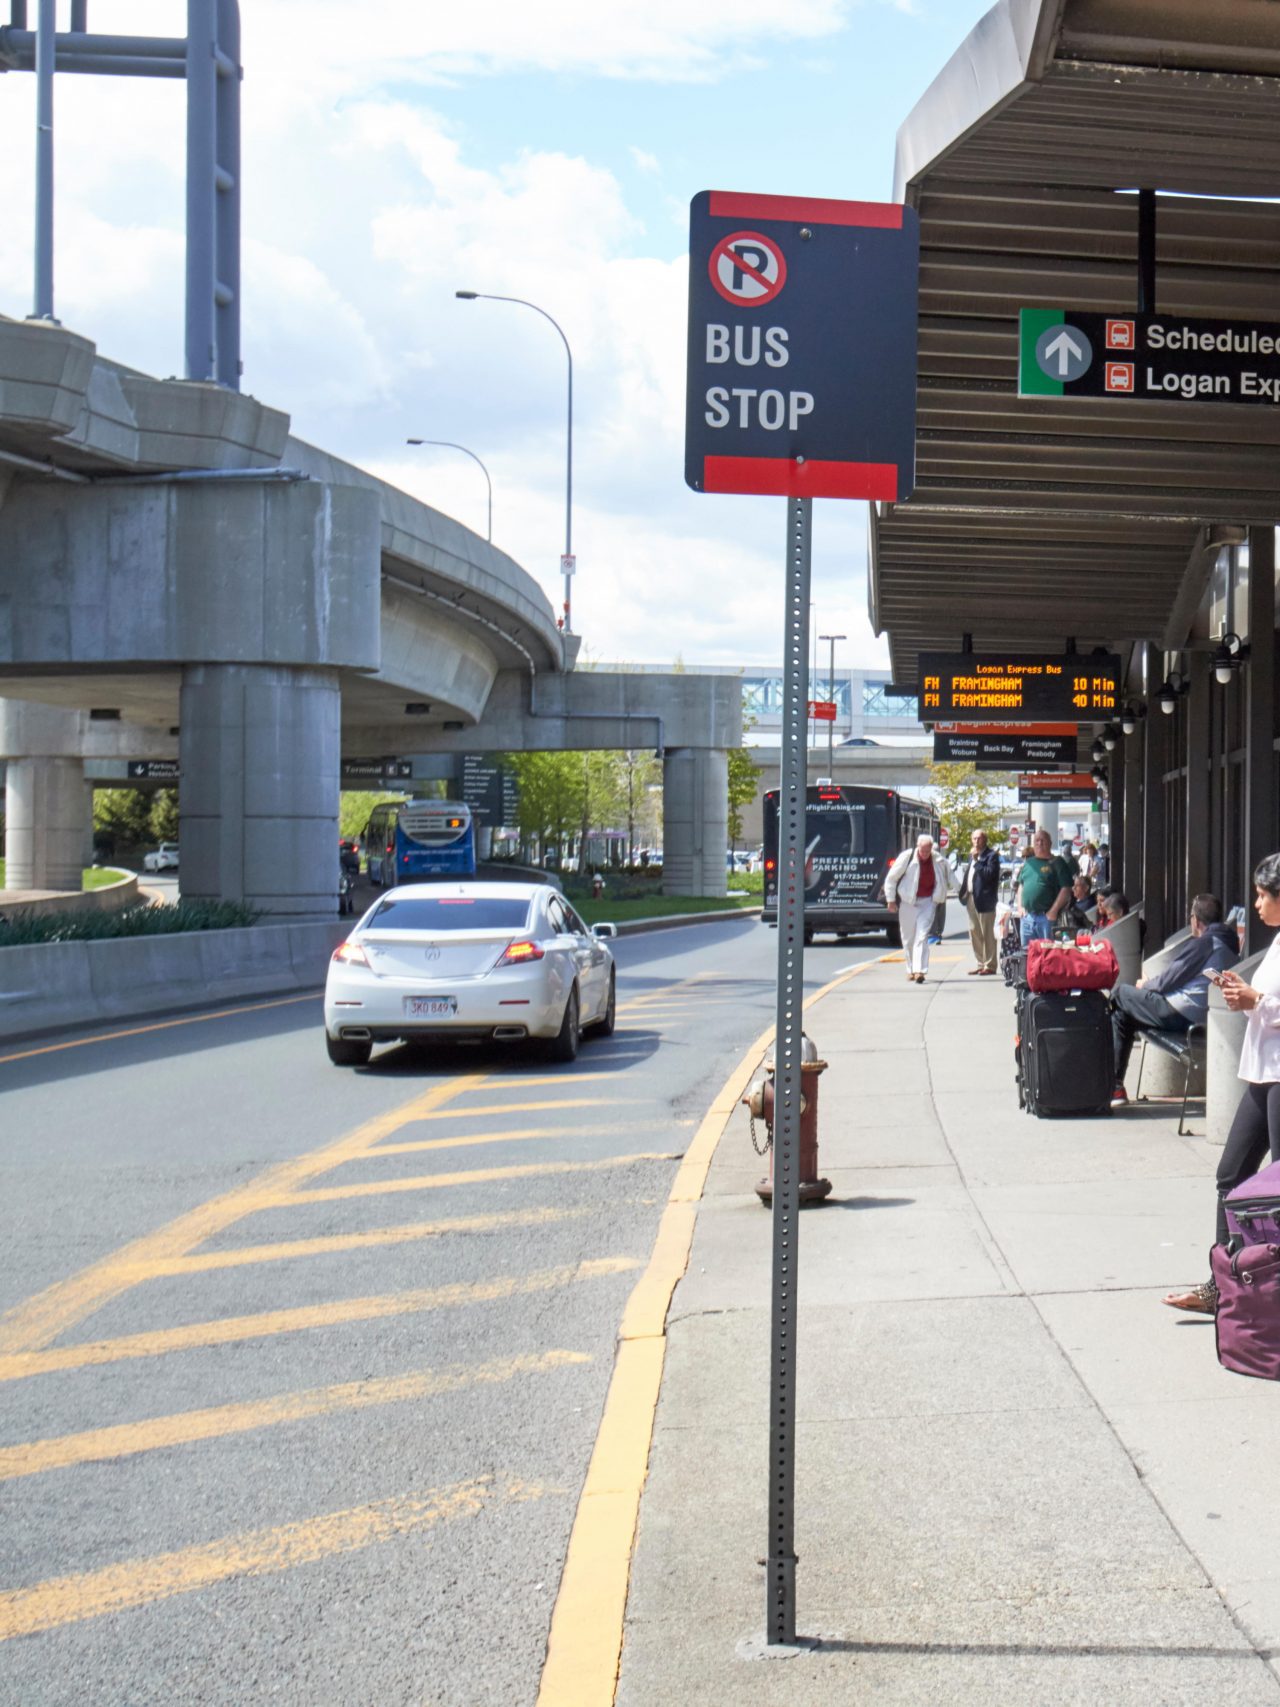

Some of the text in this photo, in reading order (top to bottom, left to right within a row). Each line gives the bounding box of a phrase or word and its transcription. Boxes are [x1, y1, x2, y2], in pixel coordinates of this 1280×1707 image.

[705, 323, 789, 368] BUS
[1146, 367, 1231, 398] Logan
[704, 386, 815, 431] STOP
[976, 665, 1062, 675] Logan Express Bus
[924, 677, 1115, 691] FH FRAMINGHAM 10 Min
[924, 693, 1115, 708] FH FRAMINGHAM 40 Min
[948, 739, 979, 747] Braintree
[1021, 740, 1062, 749] Framingham
[984, 745, 1015, 755] Back Bay
[1027, 750, 1056, 759] Peabody
[148, 762, 177, 771] Parking
[344, 765, 382, 775] Terminal
[812, 857, 875, 865] PREFLIGHT
